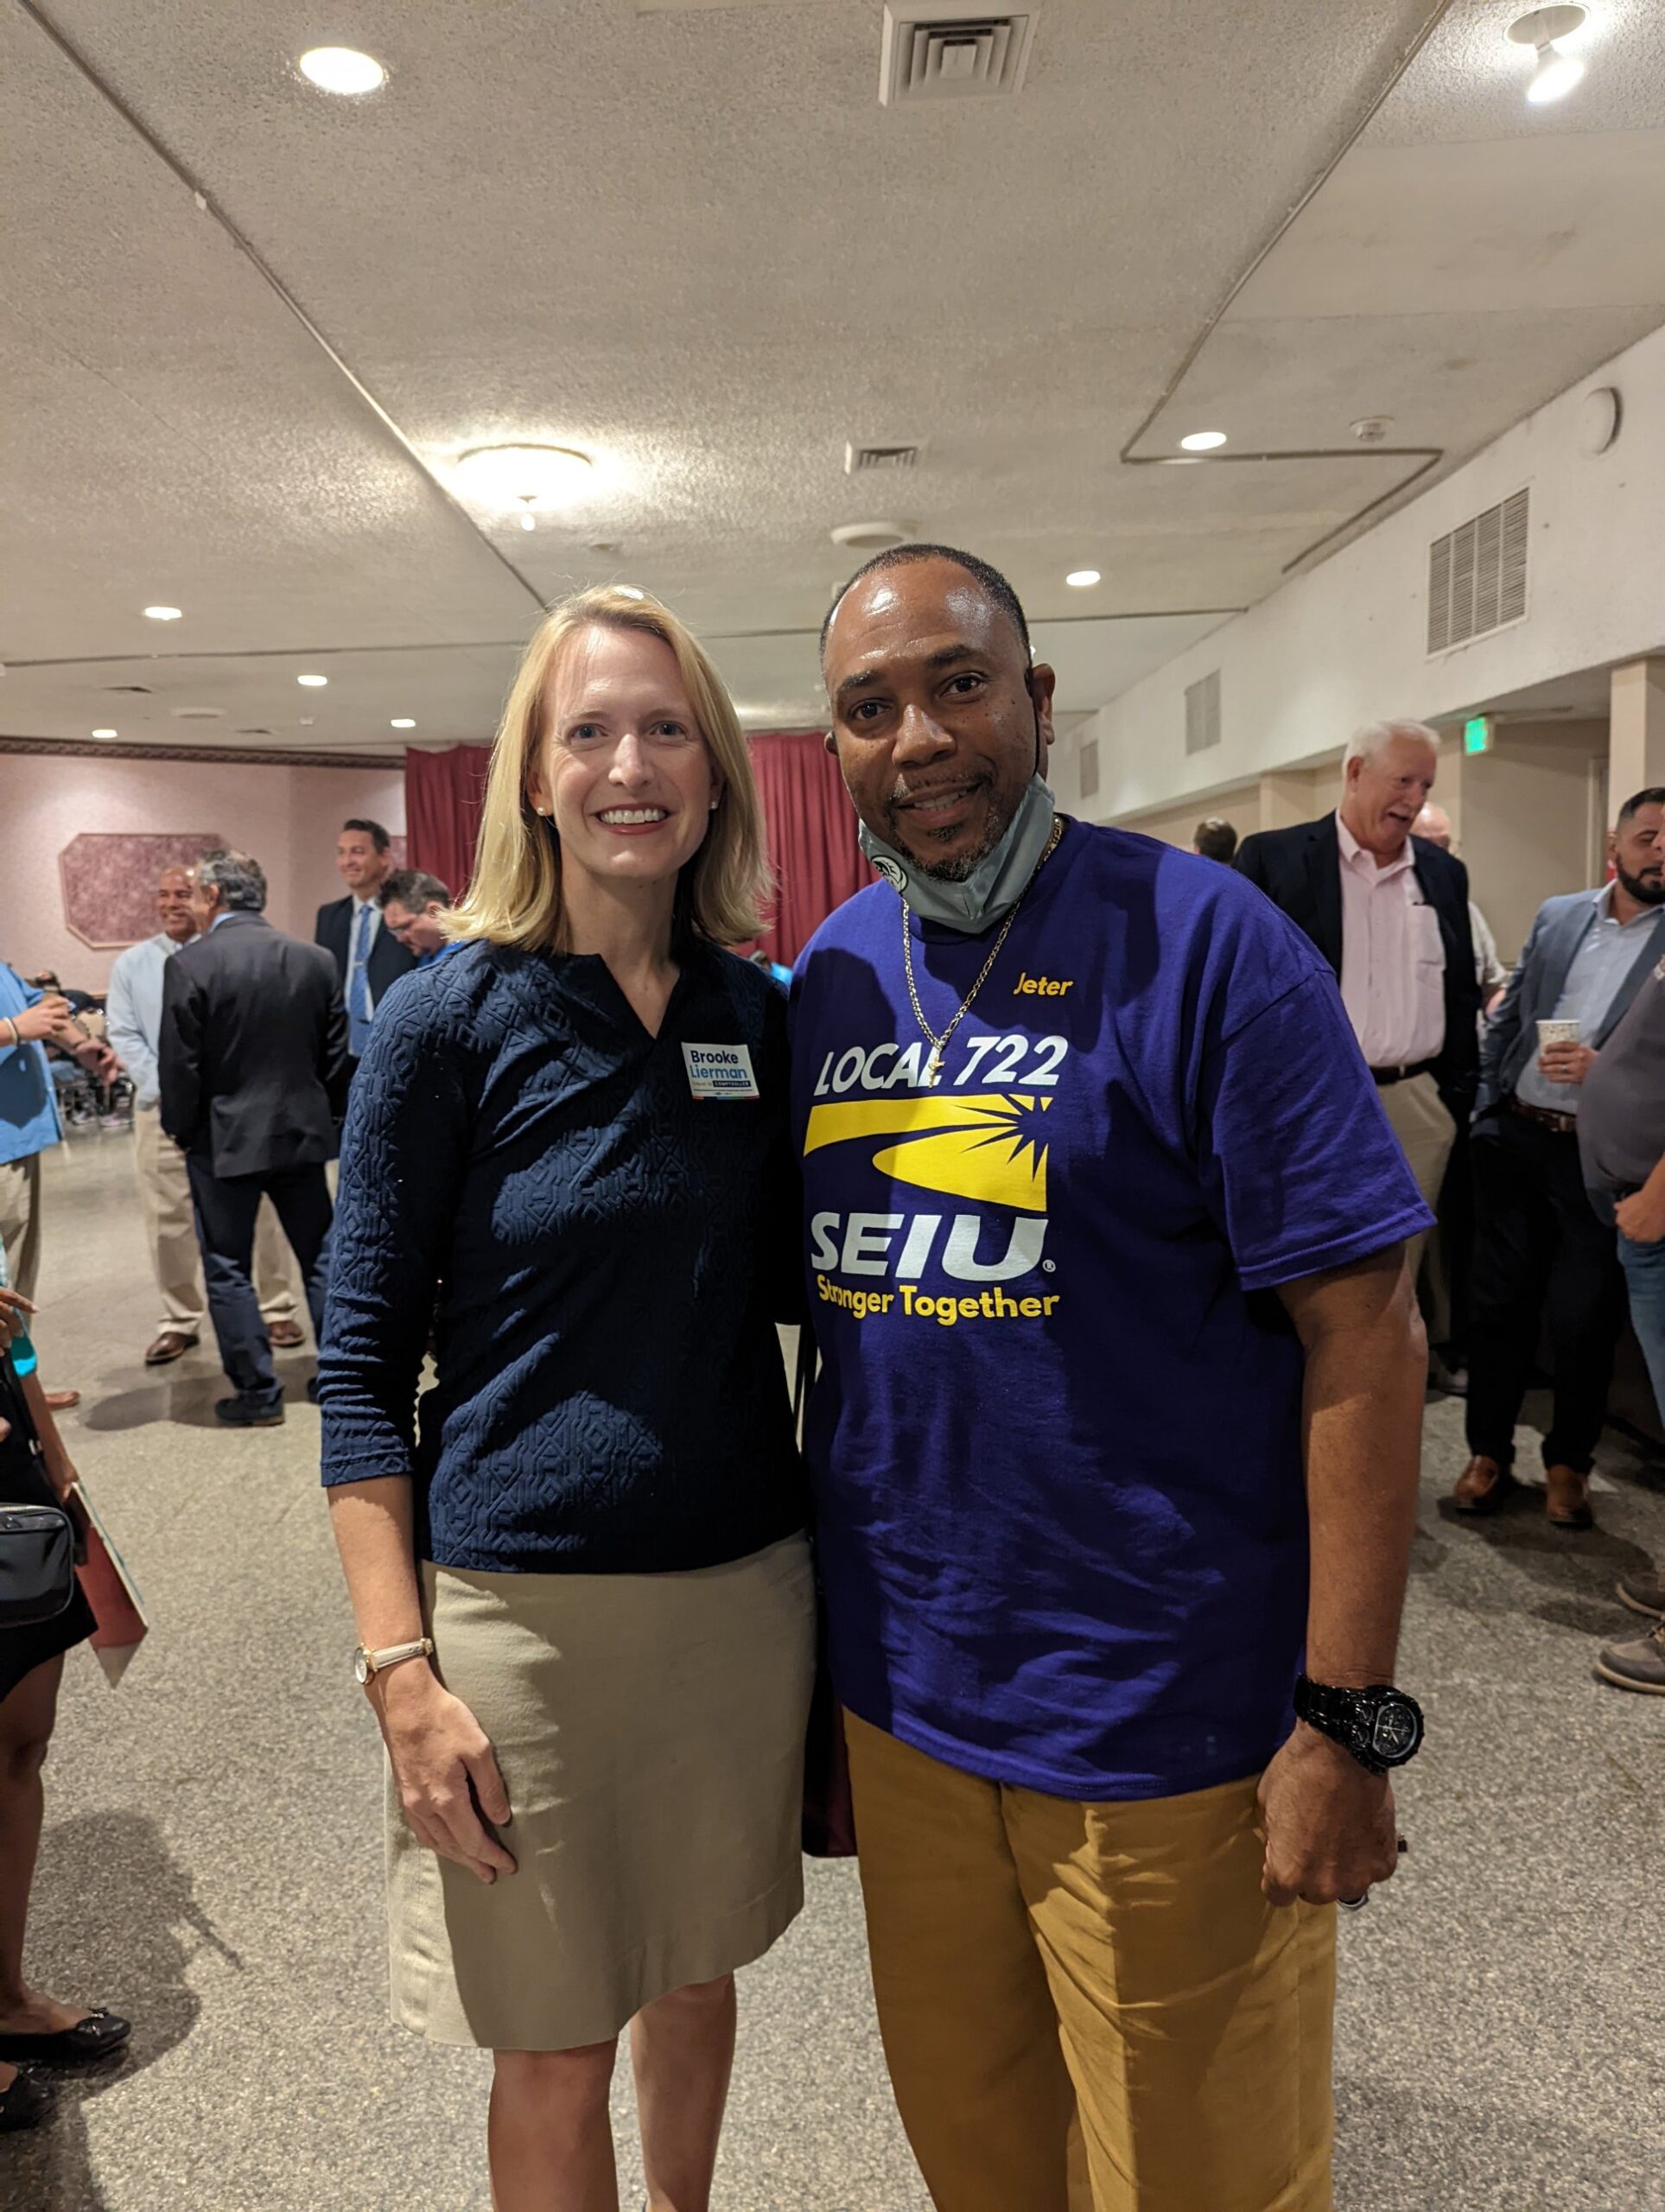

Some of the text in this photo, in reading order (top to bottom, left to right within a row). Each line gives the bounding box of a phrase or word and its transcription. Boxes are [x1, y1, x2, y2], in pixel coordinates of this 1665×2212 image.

[1013, 972, 1074, 995] Jeter
[690, 1050, 739, 1064] Brooke
[690, 1065, 747, 1078] Lierman
[813, 1034, 1069, 1096] LOCAL 722
[810, 1211, 1049, 1281] SEIU
[817, 1274, 1060, 1325] Stronger Together
